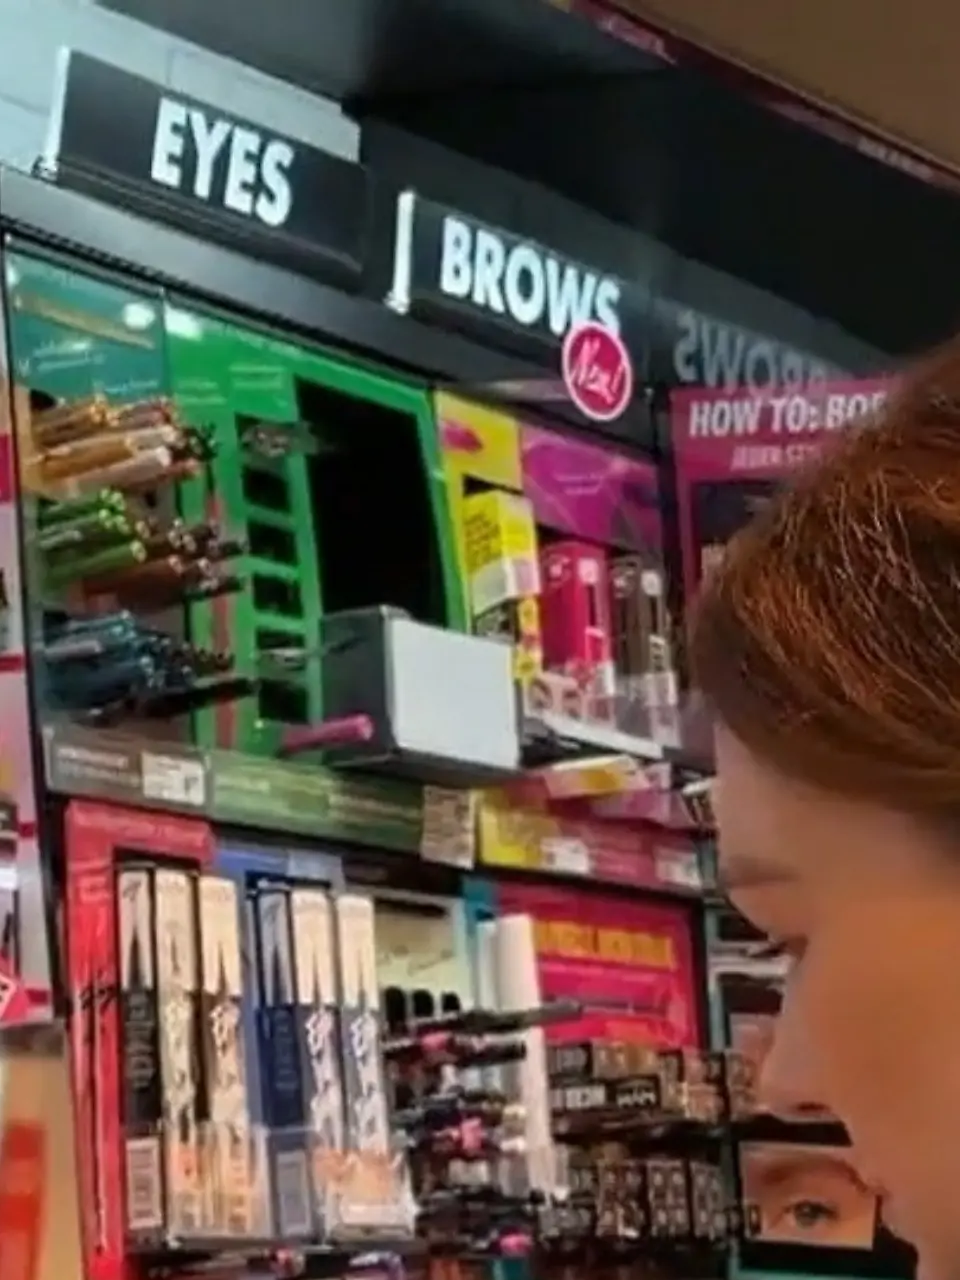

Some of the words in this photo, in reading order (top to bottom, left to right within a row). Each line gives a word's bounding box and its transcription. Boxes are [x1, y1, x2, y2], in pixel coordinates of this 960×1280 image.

[152, 97, 294, 227] EYES
[441, 217, 622, 337] BROWS
[690, 400, 760, 437] HOW
